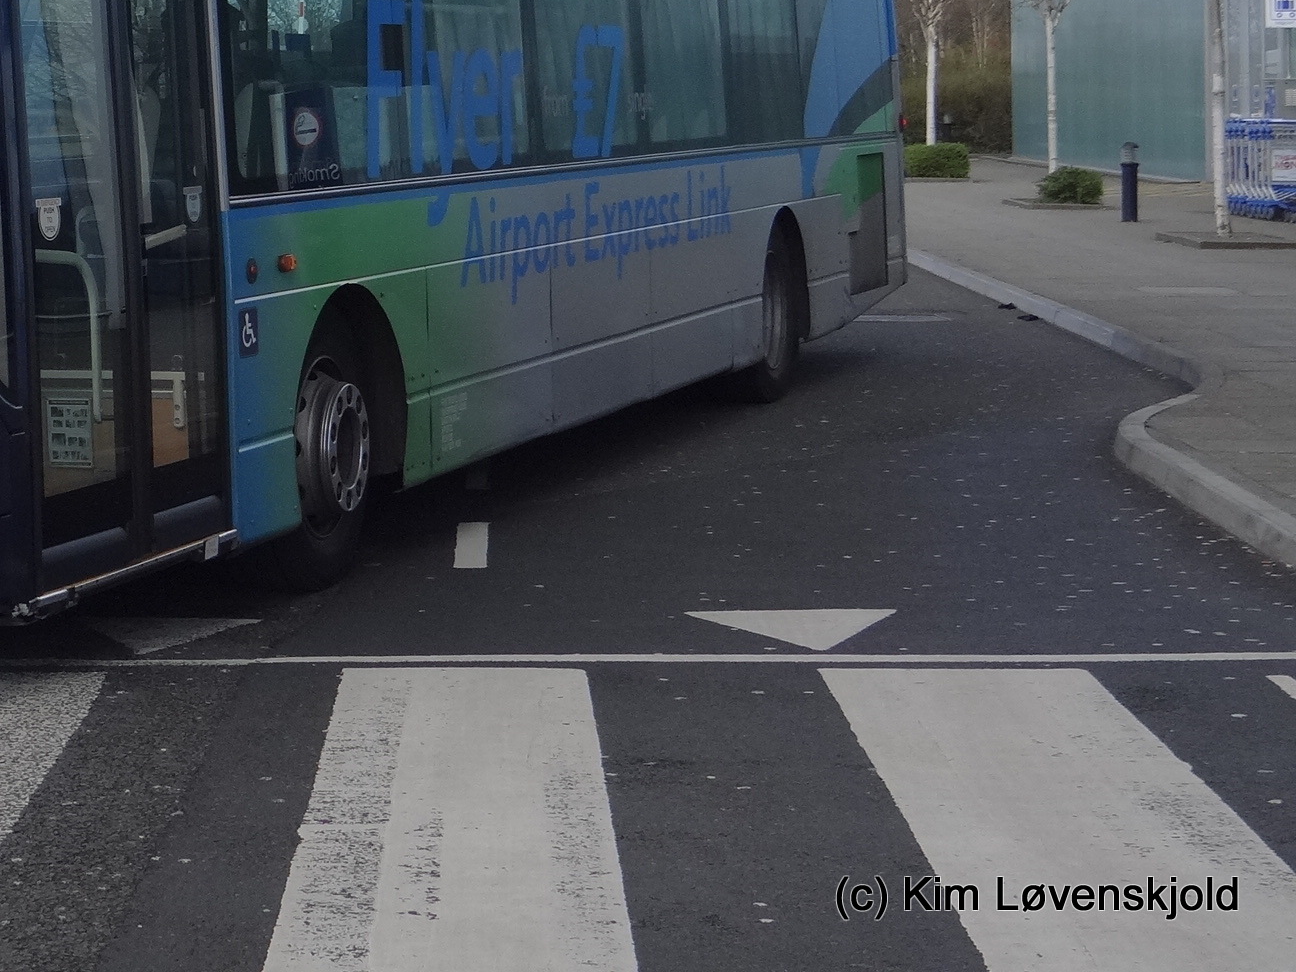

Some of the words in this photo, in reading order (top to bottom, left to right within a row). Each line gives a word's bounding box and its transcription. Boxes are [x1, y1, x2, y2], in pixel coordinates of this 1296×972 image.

[571, 25, 625, 159] £7
[460, 196, 577, 305] Airport
[584, 181, 680, 280] Express
[687, 165, 733, 242] Link
